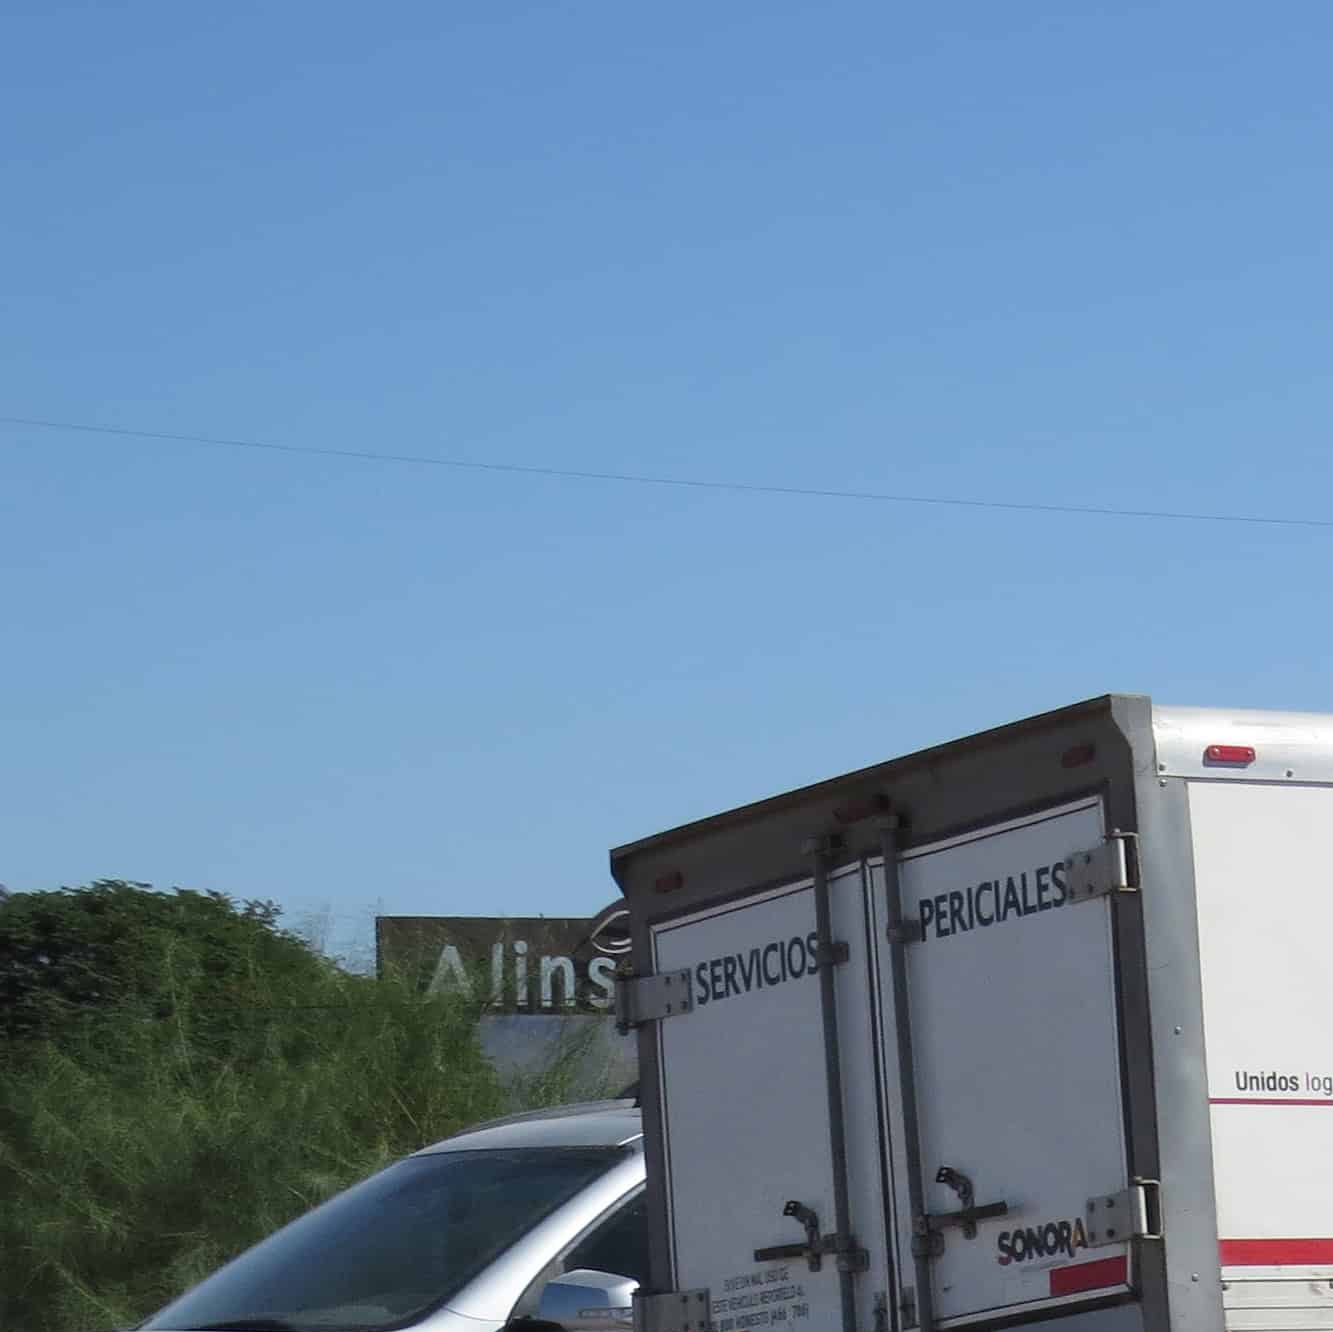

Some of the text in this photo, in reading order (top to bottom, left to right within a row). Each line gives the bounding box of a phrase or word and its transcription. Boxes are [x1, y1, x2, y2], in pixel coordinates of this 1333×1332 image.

[696, 862, 1067, 1005] SERVICIOS PERICIALES
[1235, 1071, 1300, 1092] Unidos
[998, 1217, 1088, 1266] SONORA
